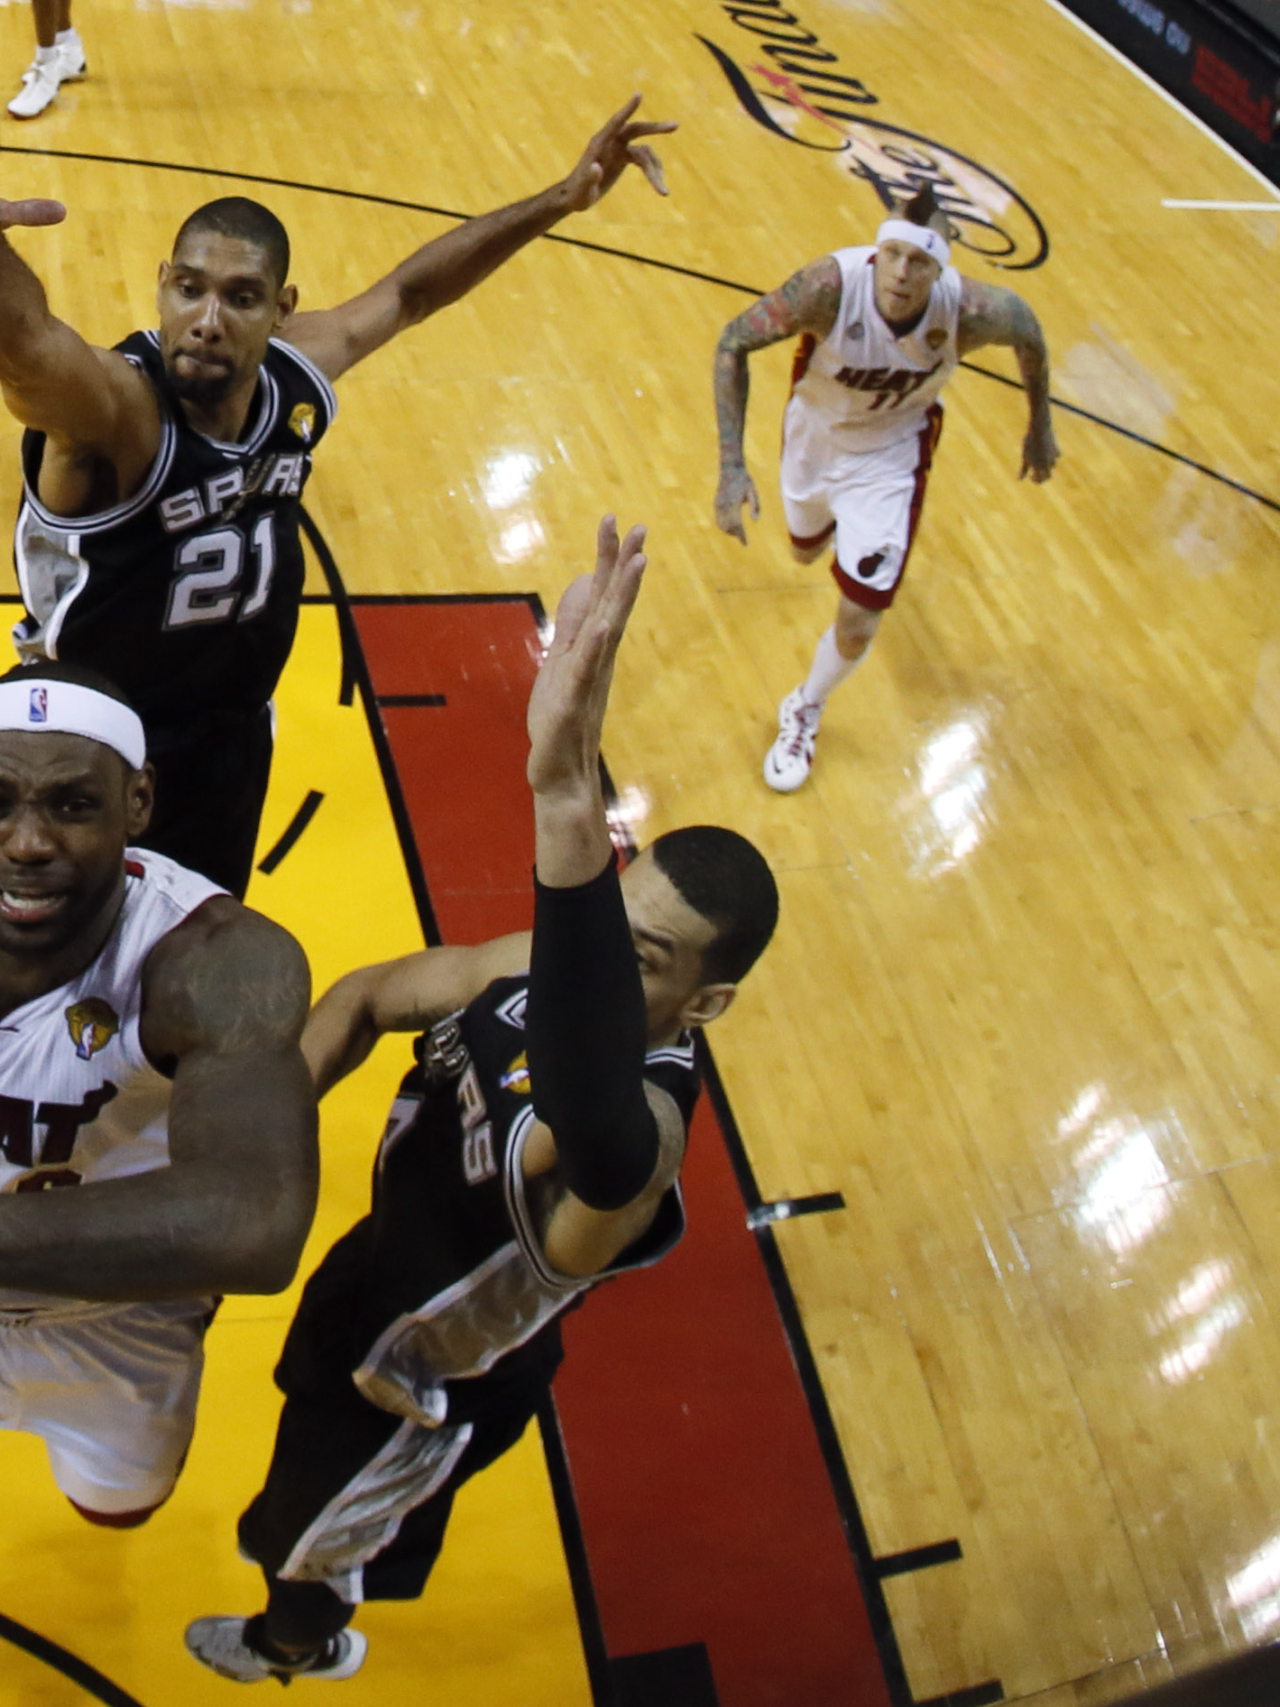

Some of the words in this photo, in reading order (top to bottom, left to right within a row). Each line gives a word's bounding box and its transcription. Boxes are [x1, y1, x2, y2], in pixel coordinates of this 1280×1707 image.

[692, 0, 1050, 271] Fina
[835, 357, 944, 391] HEAT
[162, 511, 275, 632] 21
